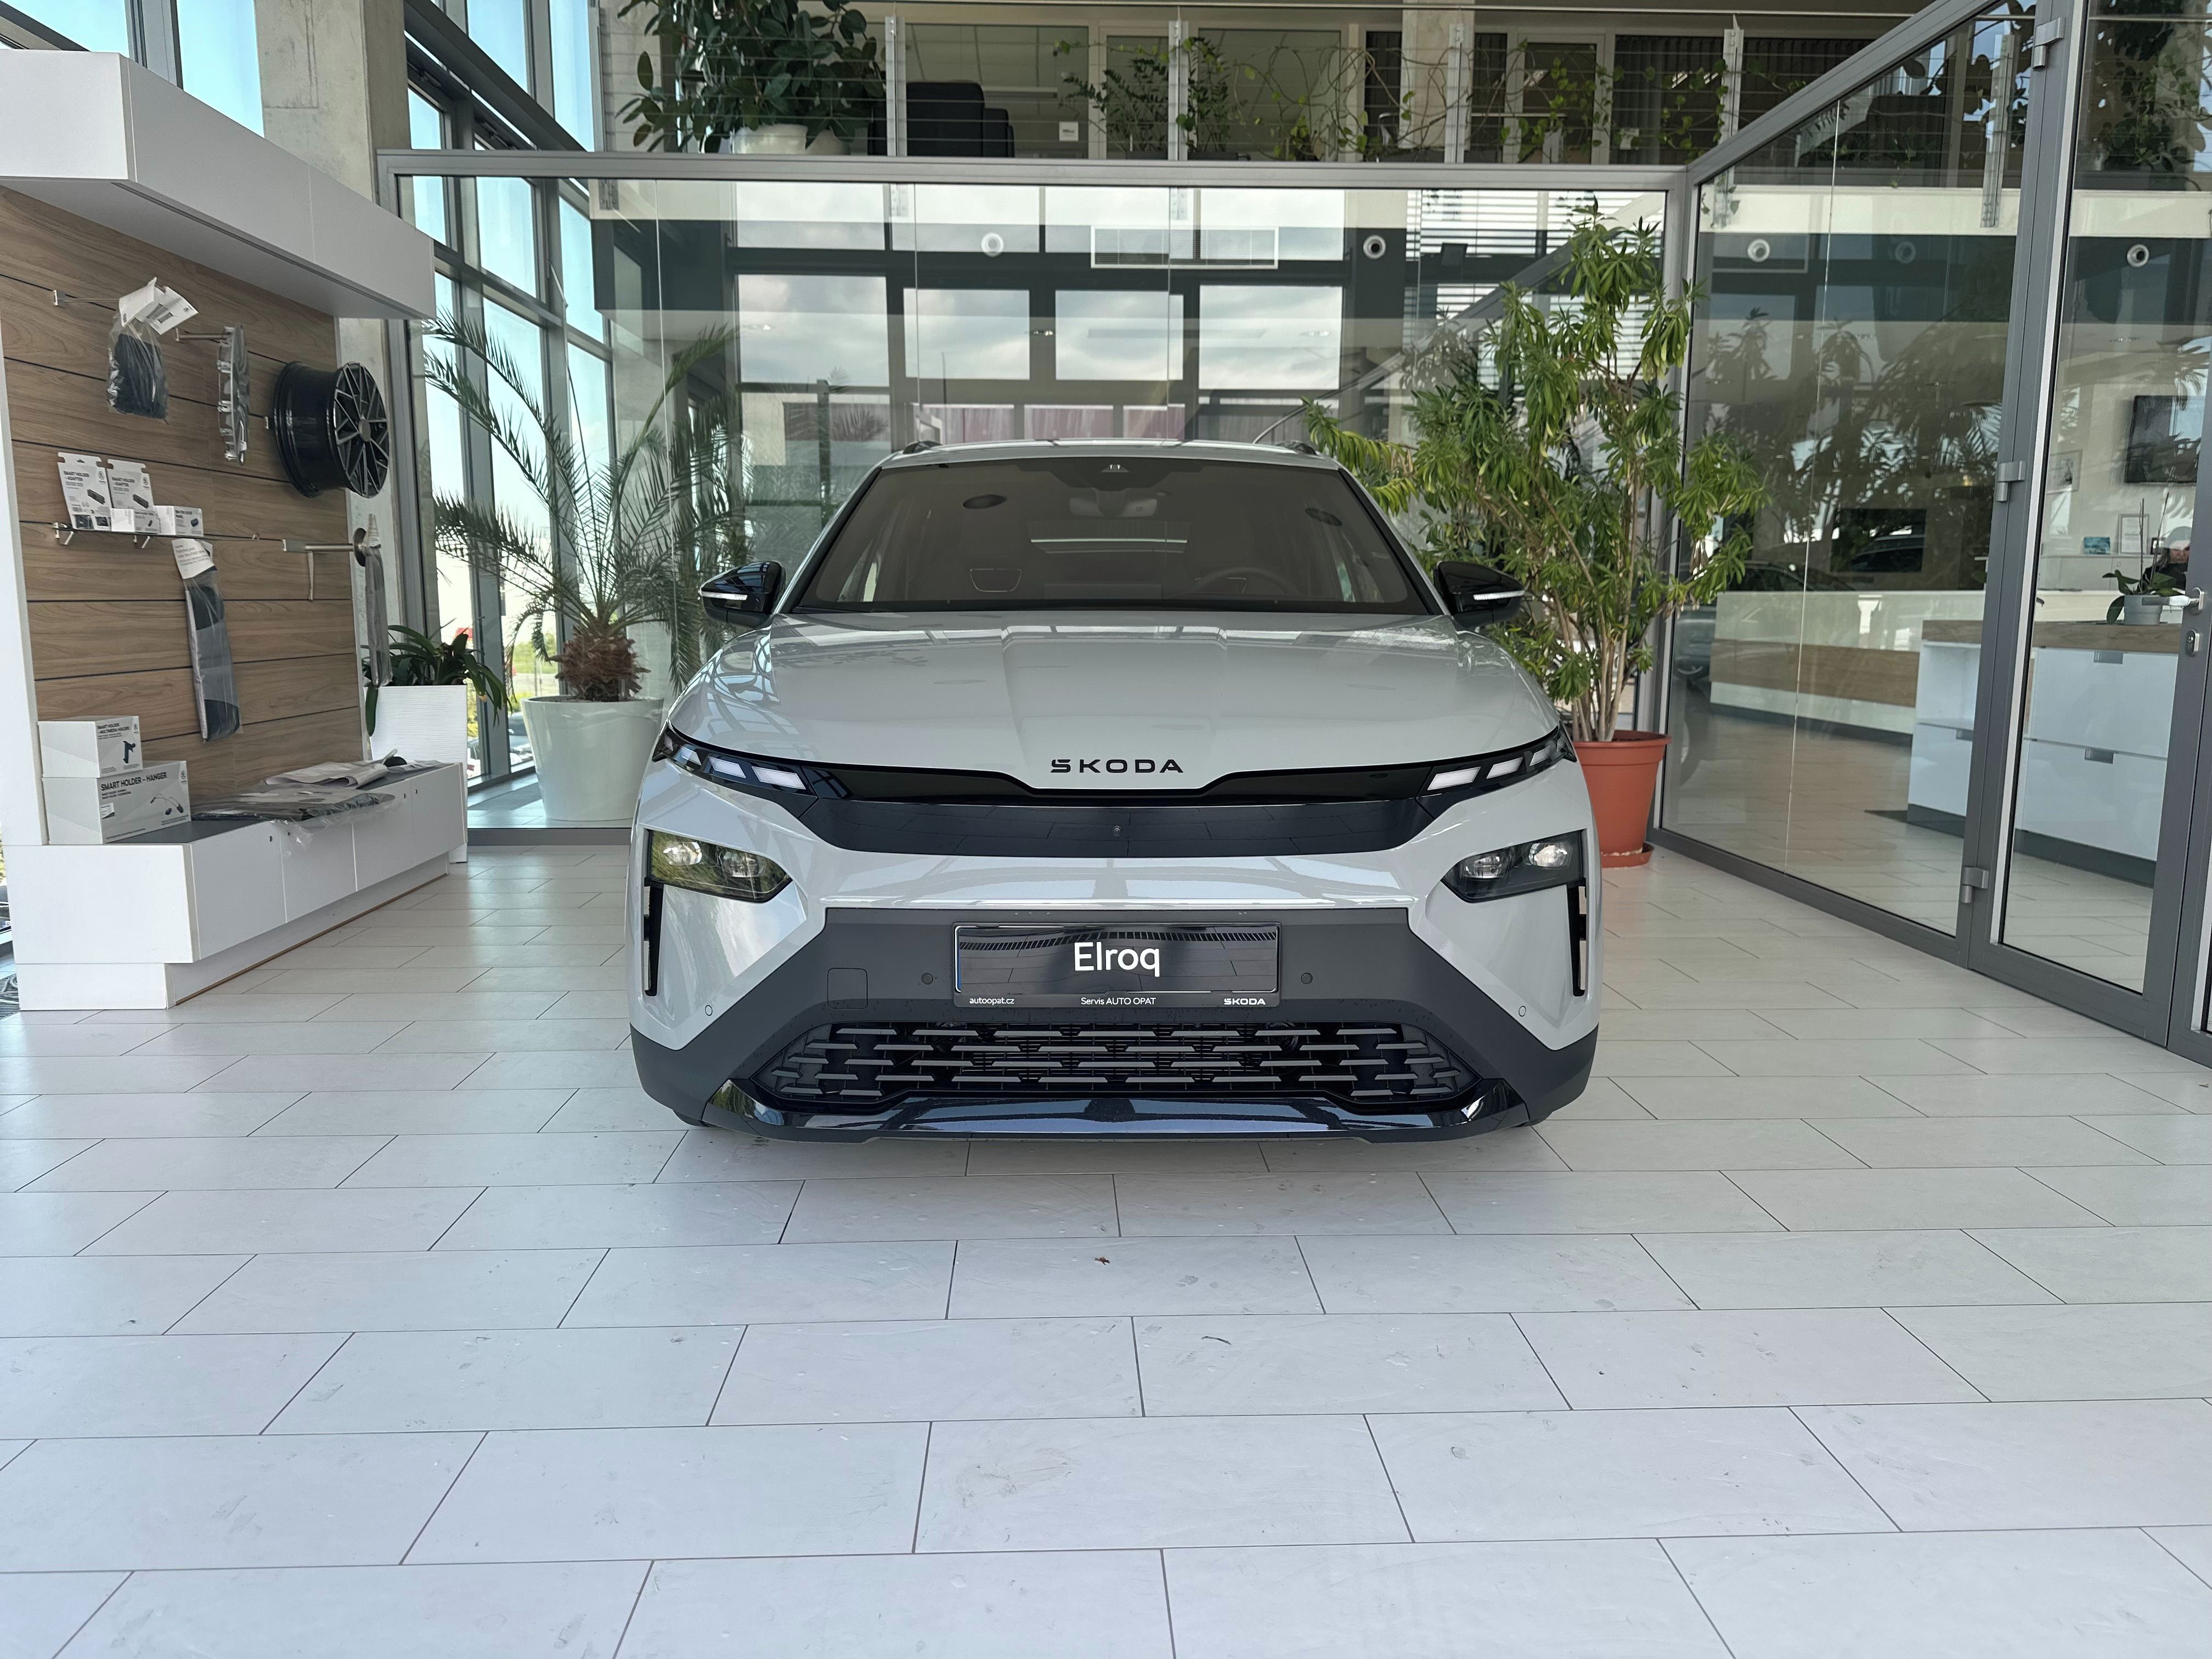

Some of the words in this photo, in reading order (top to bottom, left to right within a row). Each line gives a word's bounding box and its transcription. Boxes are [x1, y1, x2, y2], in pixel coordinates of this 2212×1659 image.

[101, 781, 120, 791] SMART
[121, 777, 142, 787] HOLDER
[146, 772, 167, 782] HANGER
[1074, 941, 1160, 977] Elroq
[969, 997, 1015, 1006] autoopat.cz
